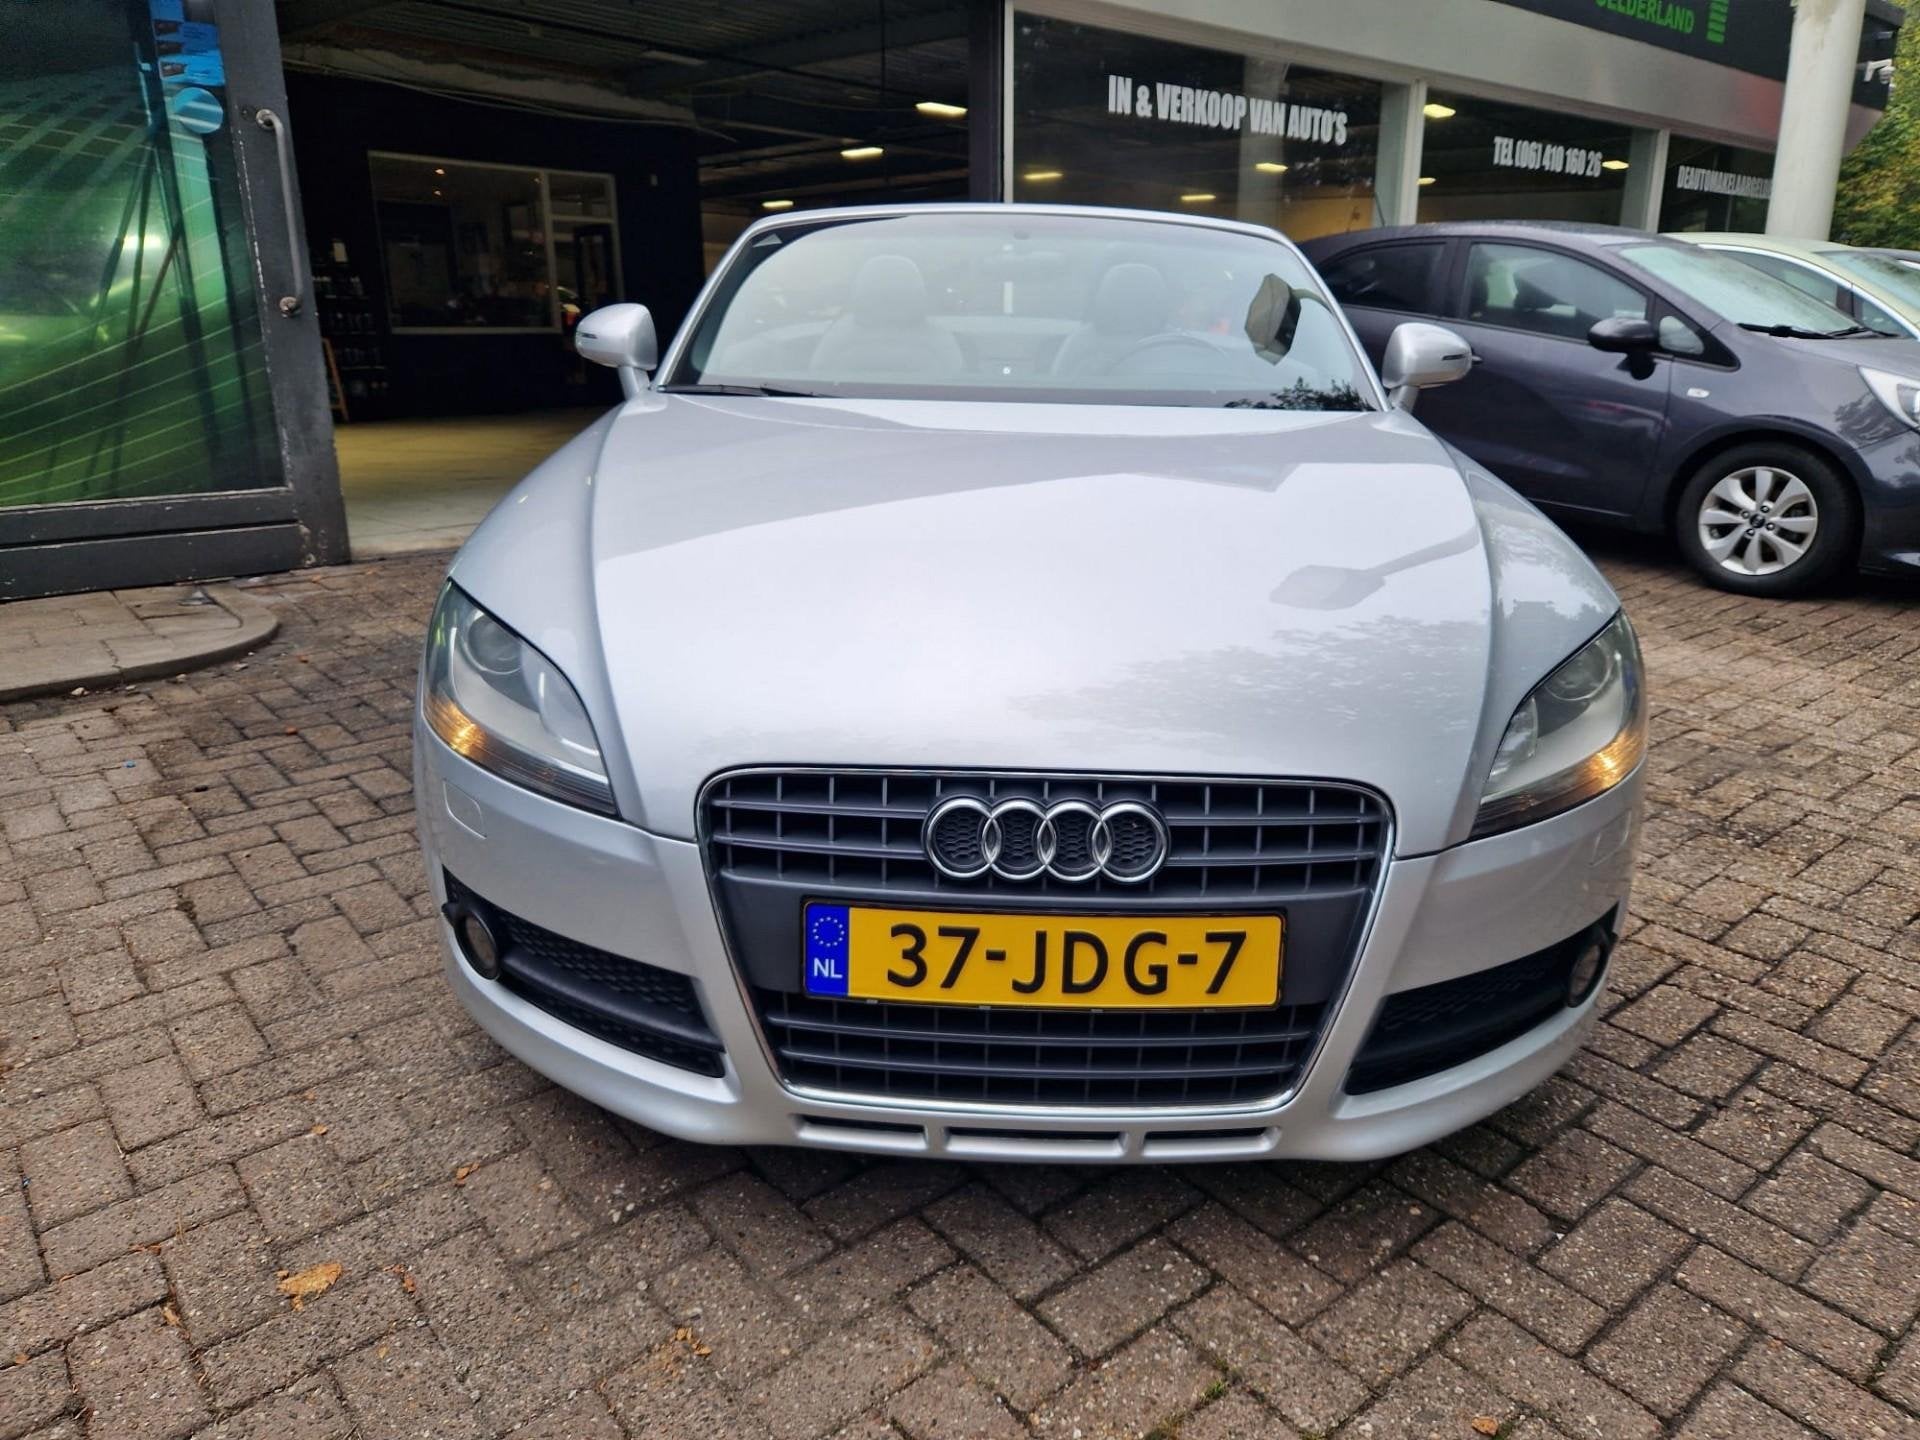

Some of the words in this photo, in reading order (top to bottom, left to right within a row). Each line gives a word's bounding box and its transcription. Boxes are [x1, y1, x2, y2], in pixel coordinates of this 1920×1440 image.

[1595, 0, 1695, 34] LDERLAND
[1108, 75, 1132, 115] IN
[1136, 85, 1152, 117] &
[1156, 82, 1247, 130] VERKOOP
[1250, 98, 1286, 136] VAN
[1287, 104, 1348, 146] AUTO'S
[813, 957, 842, 980] NL
[887, 923, 1247, 996] 37-JDG-7
